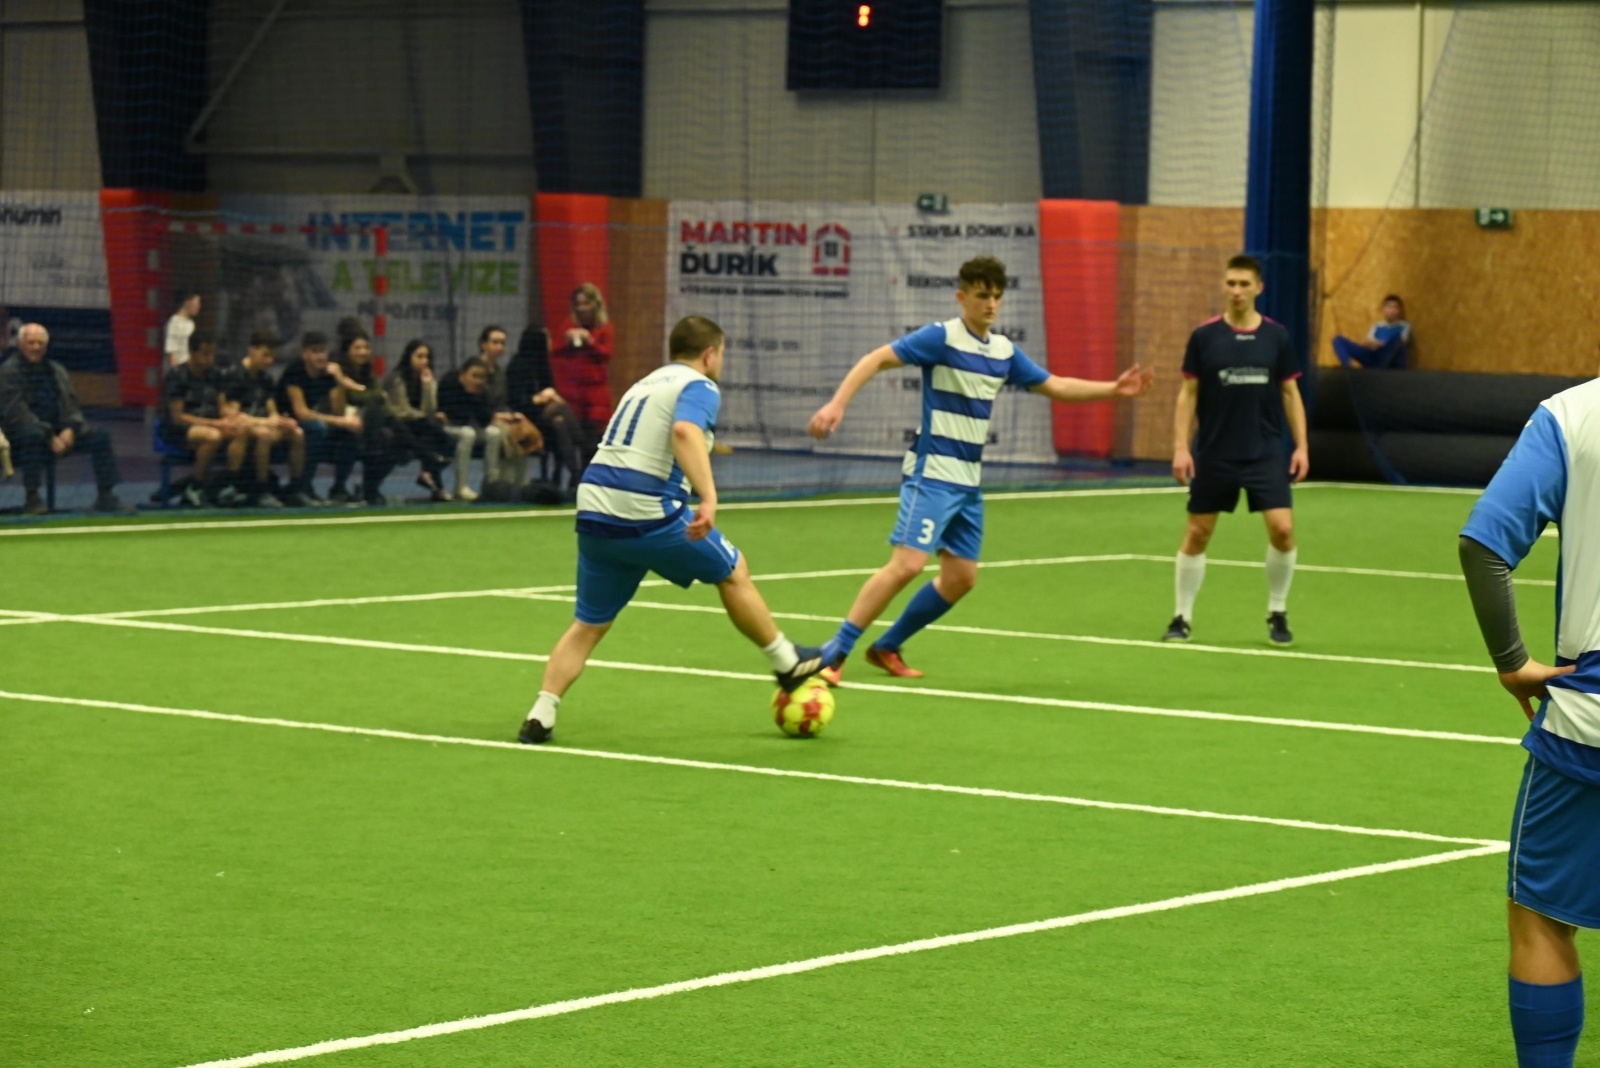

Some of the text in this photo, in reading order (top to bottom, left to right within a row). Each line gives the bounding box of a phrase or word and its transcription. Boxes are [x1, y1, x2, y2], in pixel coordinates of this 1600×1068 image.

[306, 211, 524, 252] INTERNET
[680, 221, 808, 246] MARTIN
[908, 224, 962, 238] STAVBA
[331, 260, 520, 294] A TELEVIZE
[680, 245, 779, 277] ĎURÍK
[604, 395, 650, 447] 11
[917, 518, 935, 545] 3
